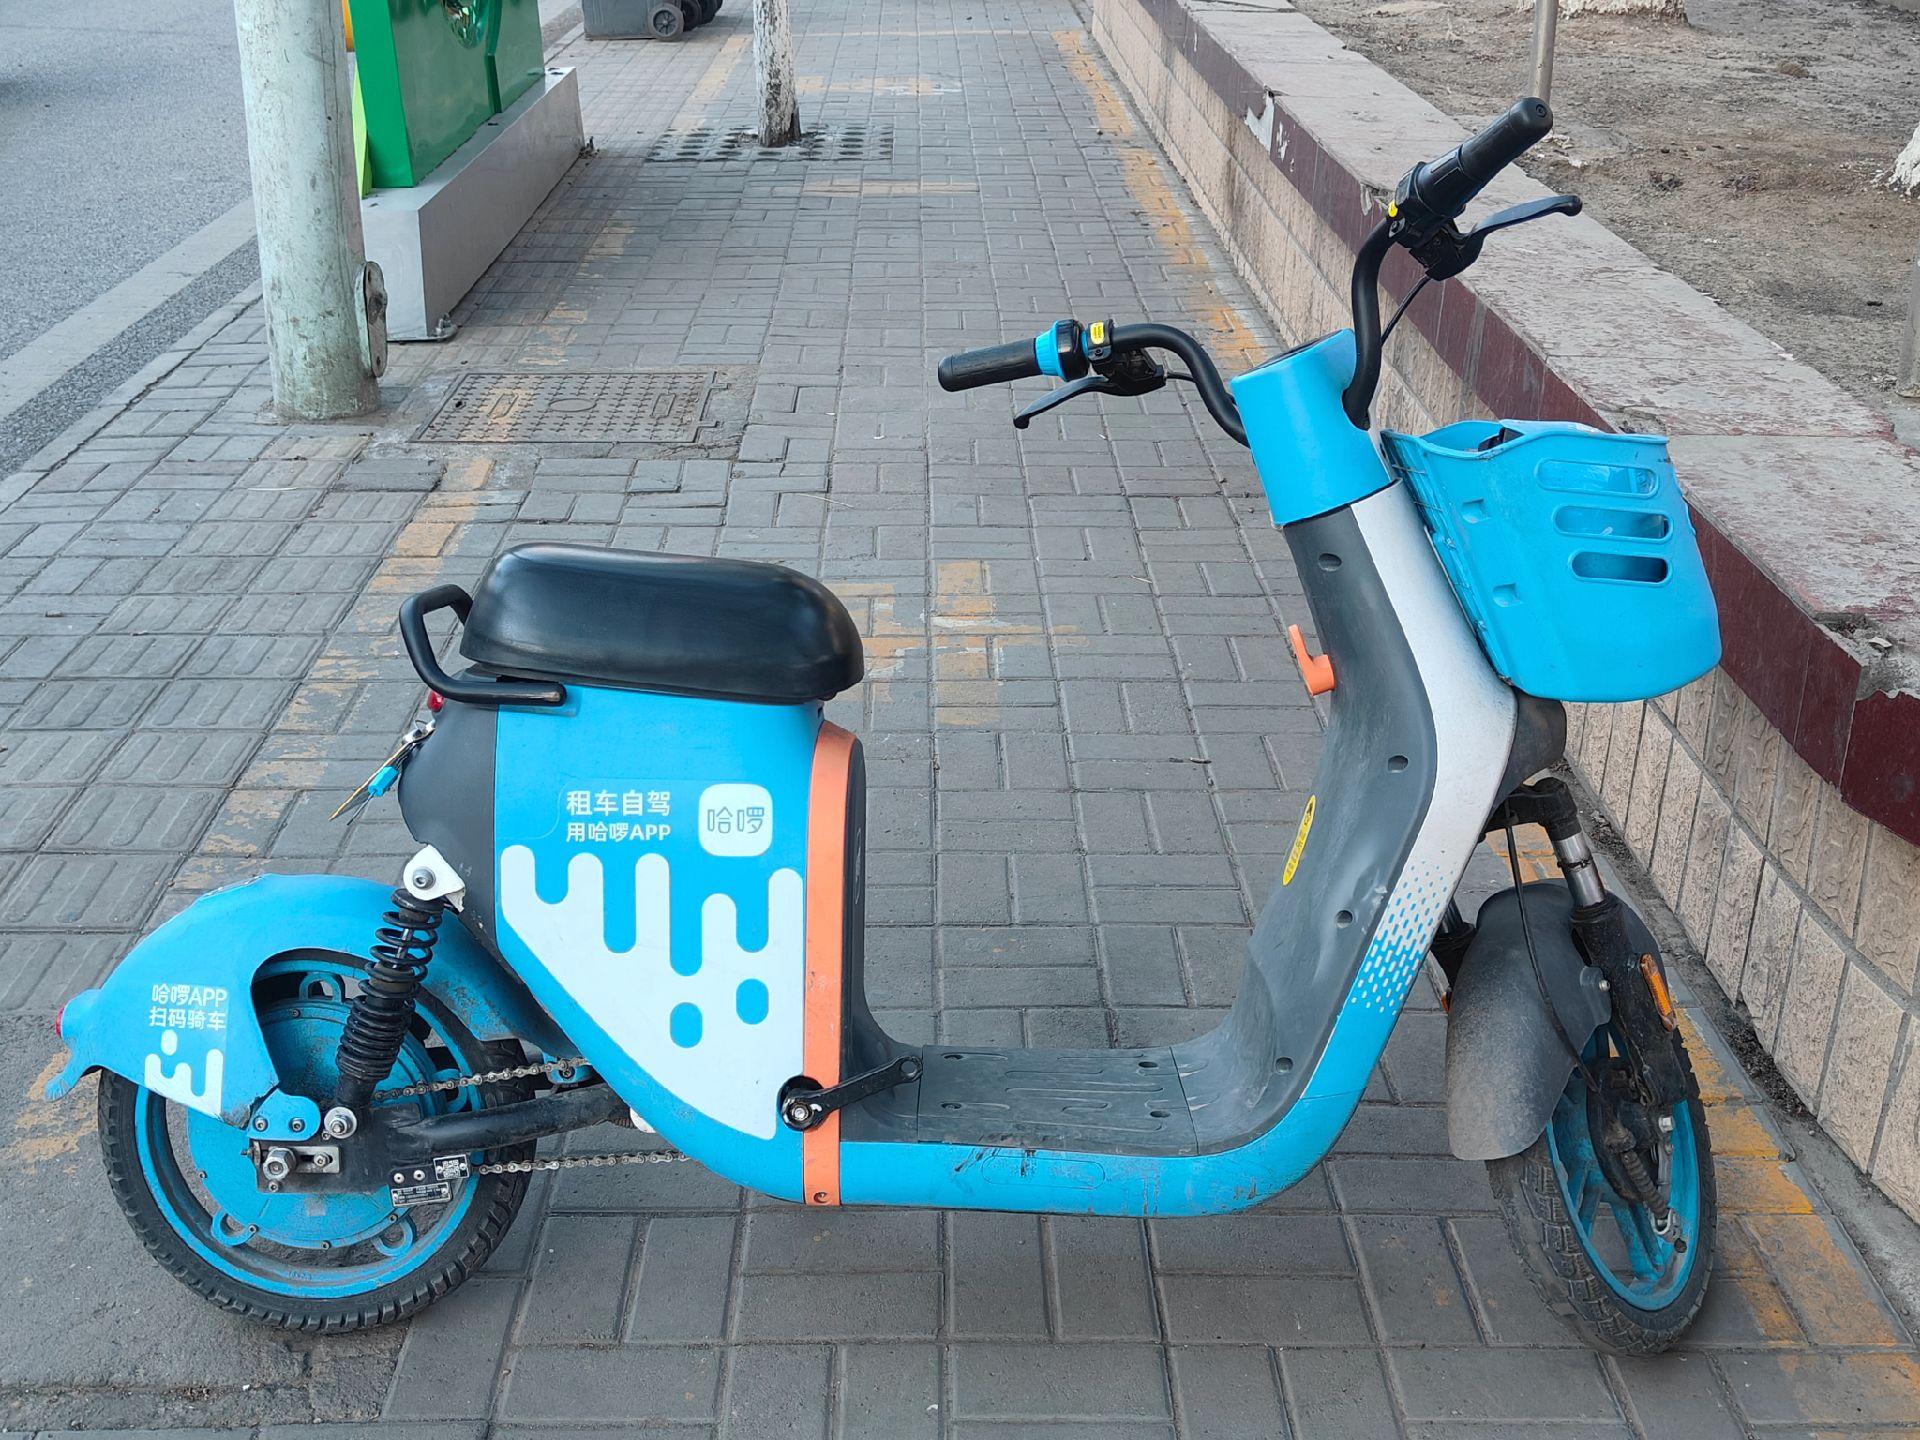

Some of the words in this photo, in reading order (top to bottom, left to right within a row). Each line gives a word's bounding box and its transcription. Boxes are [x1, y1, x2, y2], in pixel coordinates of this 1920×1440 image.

[566, 789, 671, 817] 租车自驾
[566, 822, 671, 843] 用哈啰APP
[707, 807, 765, 834] 哈啰
[151, 983, 227, 1007] 哈啰APP
[149, 1006, 226, 1031] 扫码骑车
